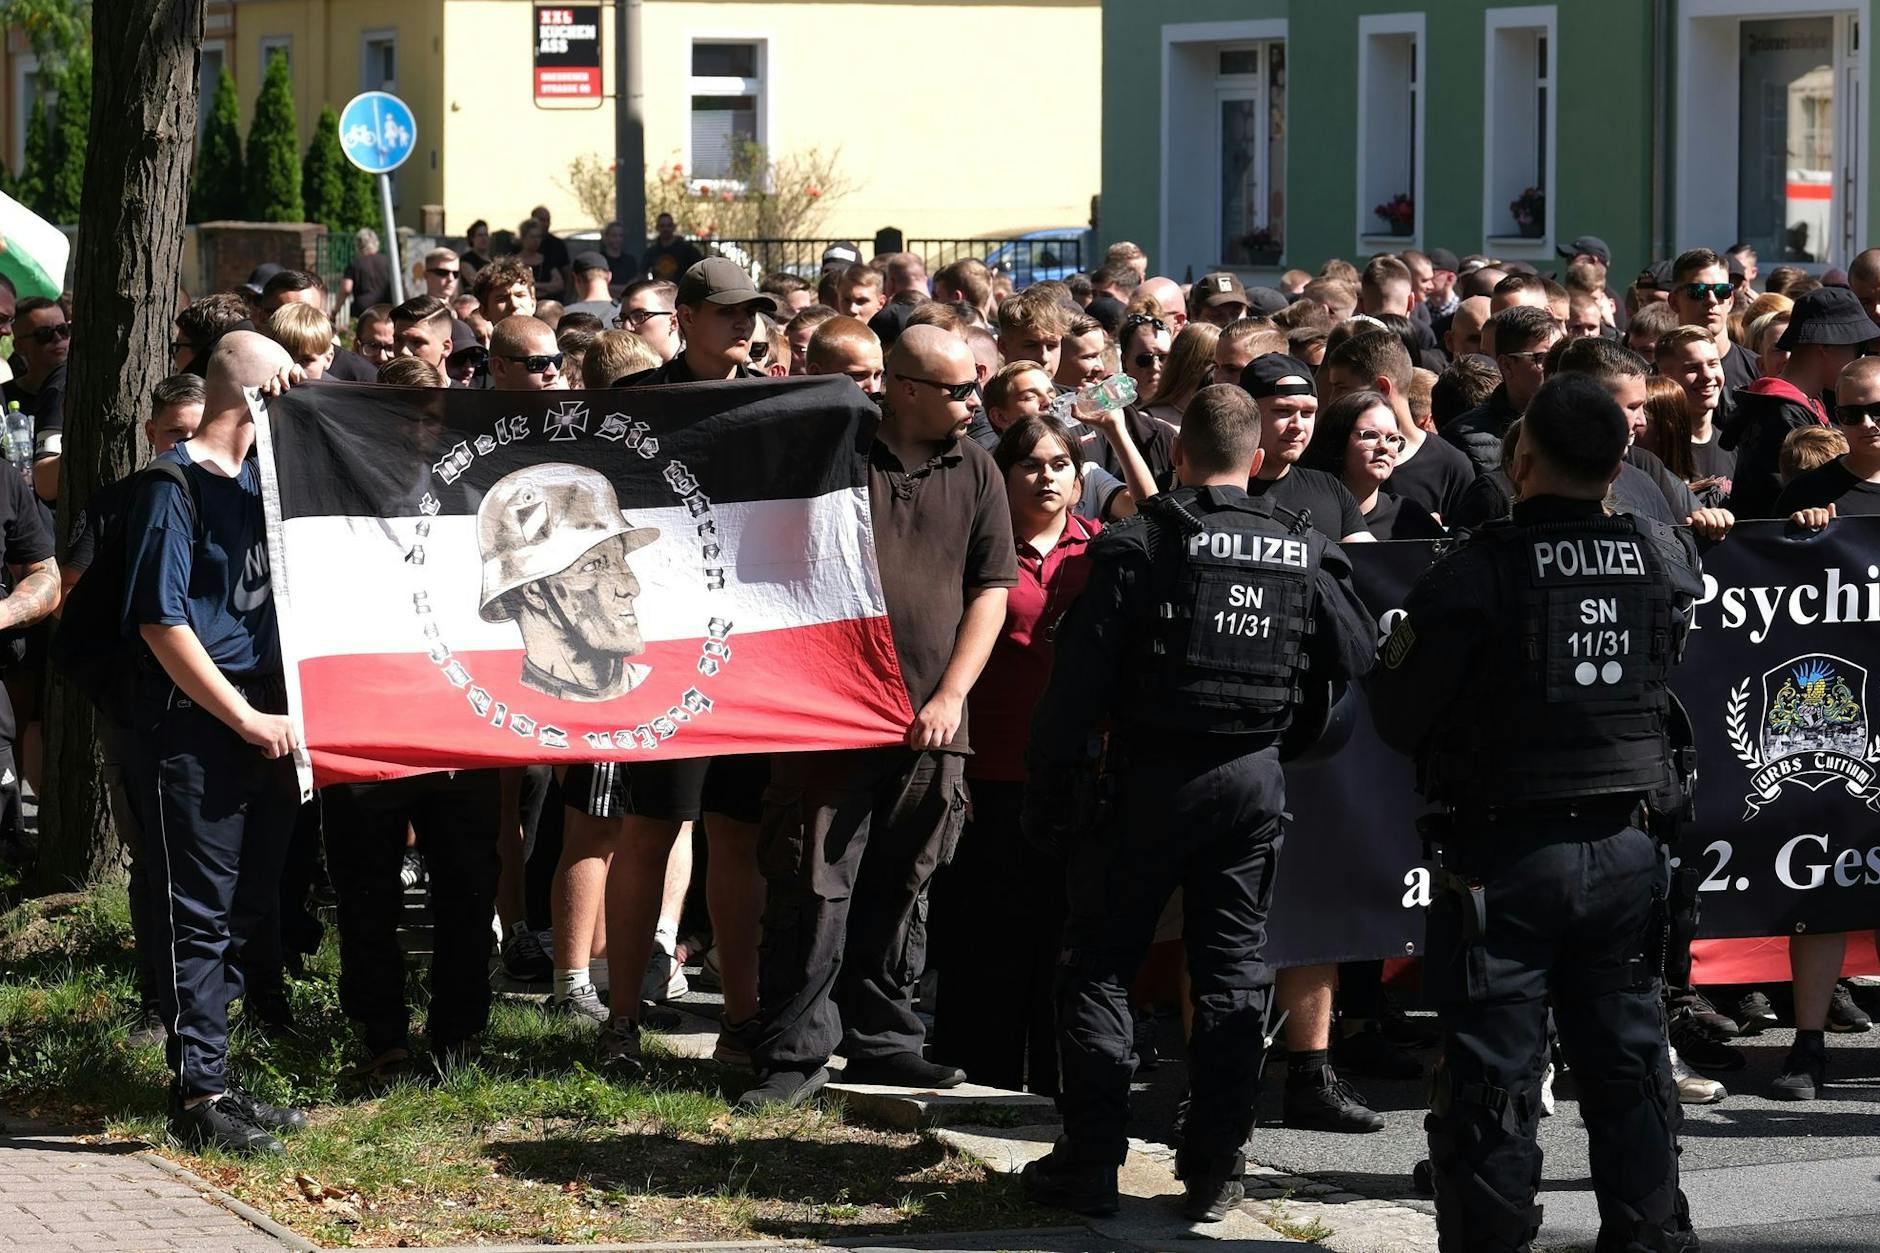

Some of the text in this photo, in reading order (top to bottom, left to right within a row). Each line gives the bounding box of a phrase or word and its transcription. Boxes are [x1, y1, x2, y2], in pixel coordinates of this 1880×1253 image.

[541, 10, 573, 24] XXL
[540, 39, 568, 53] ASS
[432, 416, 530, 485] Welt
[594, 412, 660, 459] Sie
[405, 492, 441, 565] der
[1188, 531, 1308, 569] POLIZEI
[1534, 539, 1645, 578] POLIZEI
[1228, 584, 1264, 609] SN
[1580, 598, 1618, 625] SN
[1213, 611, 1272, 639] 11/31
[698, 616, 733, 677] die
[1567, 629, 1631, 658] 11/31
[1814, 752, 1870, 784] Turrium
[1698, 840, 1749, 891] 2.
